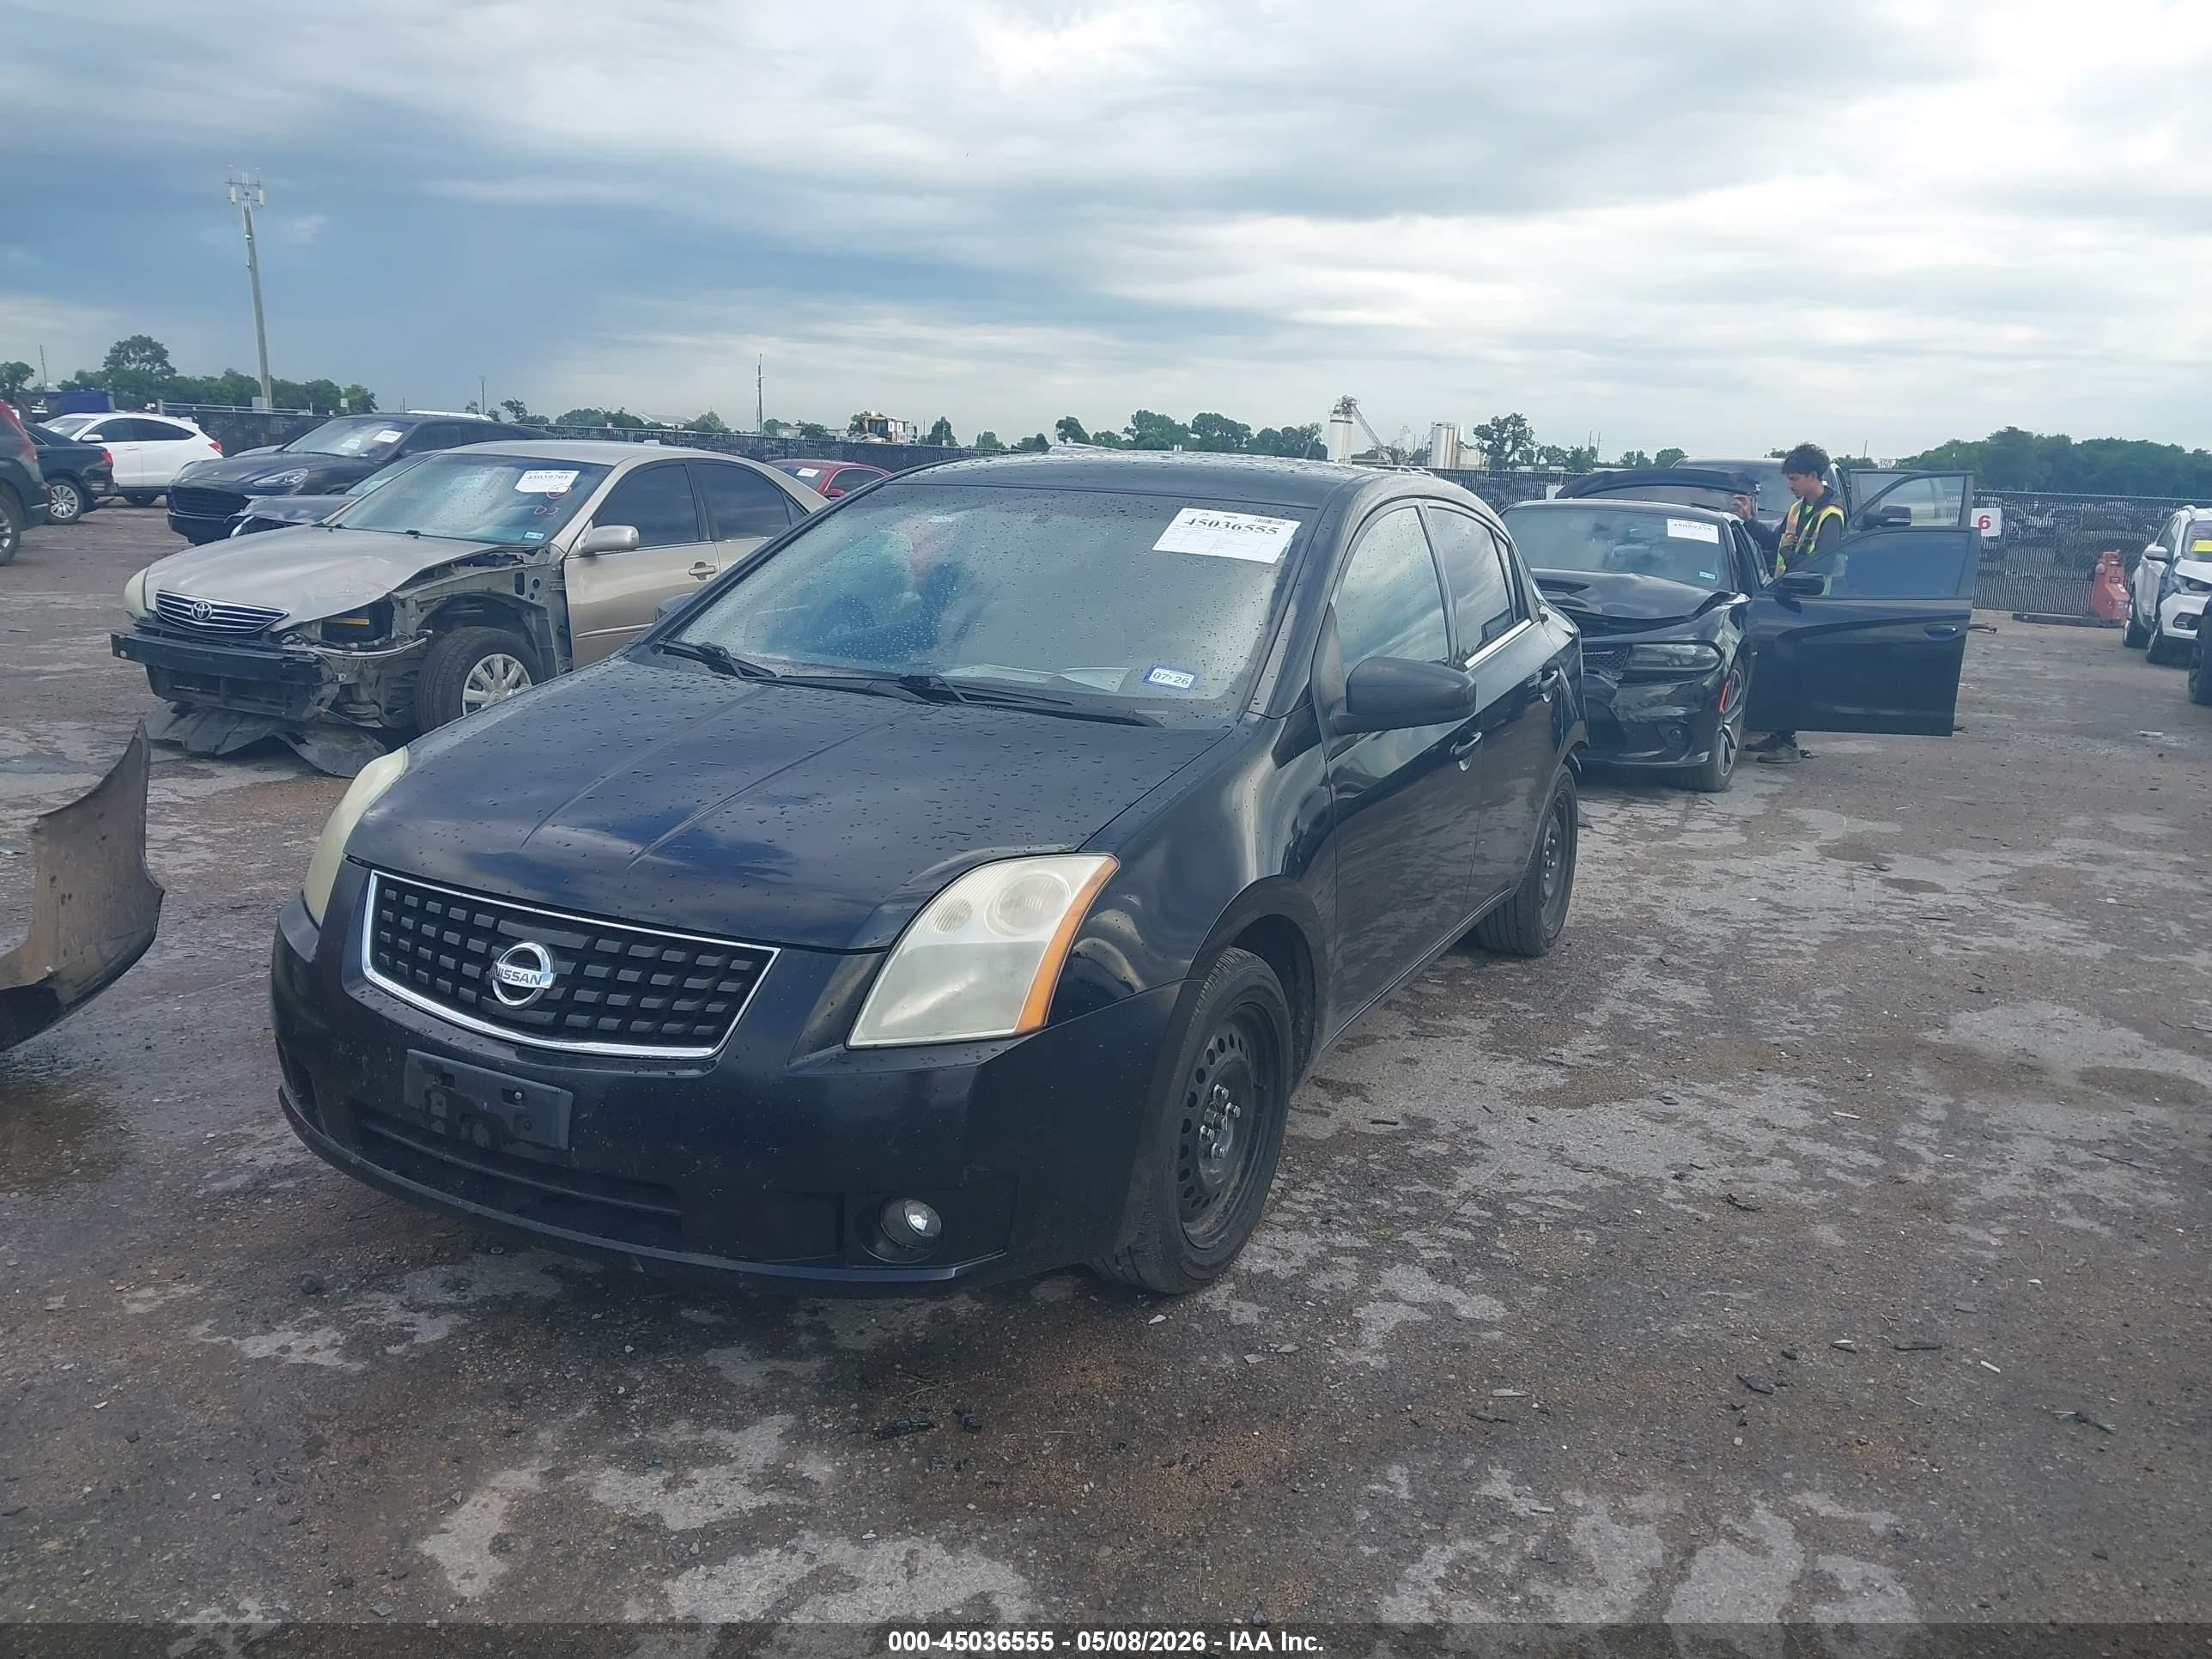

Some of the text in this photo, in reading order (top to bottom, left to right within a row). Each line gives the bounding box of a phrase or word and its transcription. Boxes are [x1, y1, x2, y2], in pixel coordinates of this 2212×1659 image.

[1184, 518, 1280, 536] 45036555
[1978, 515, 1991, 529] 6
[490, 963, 542, 986] NISSAN
